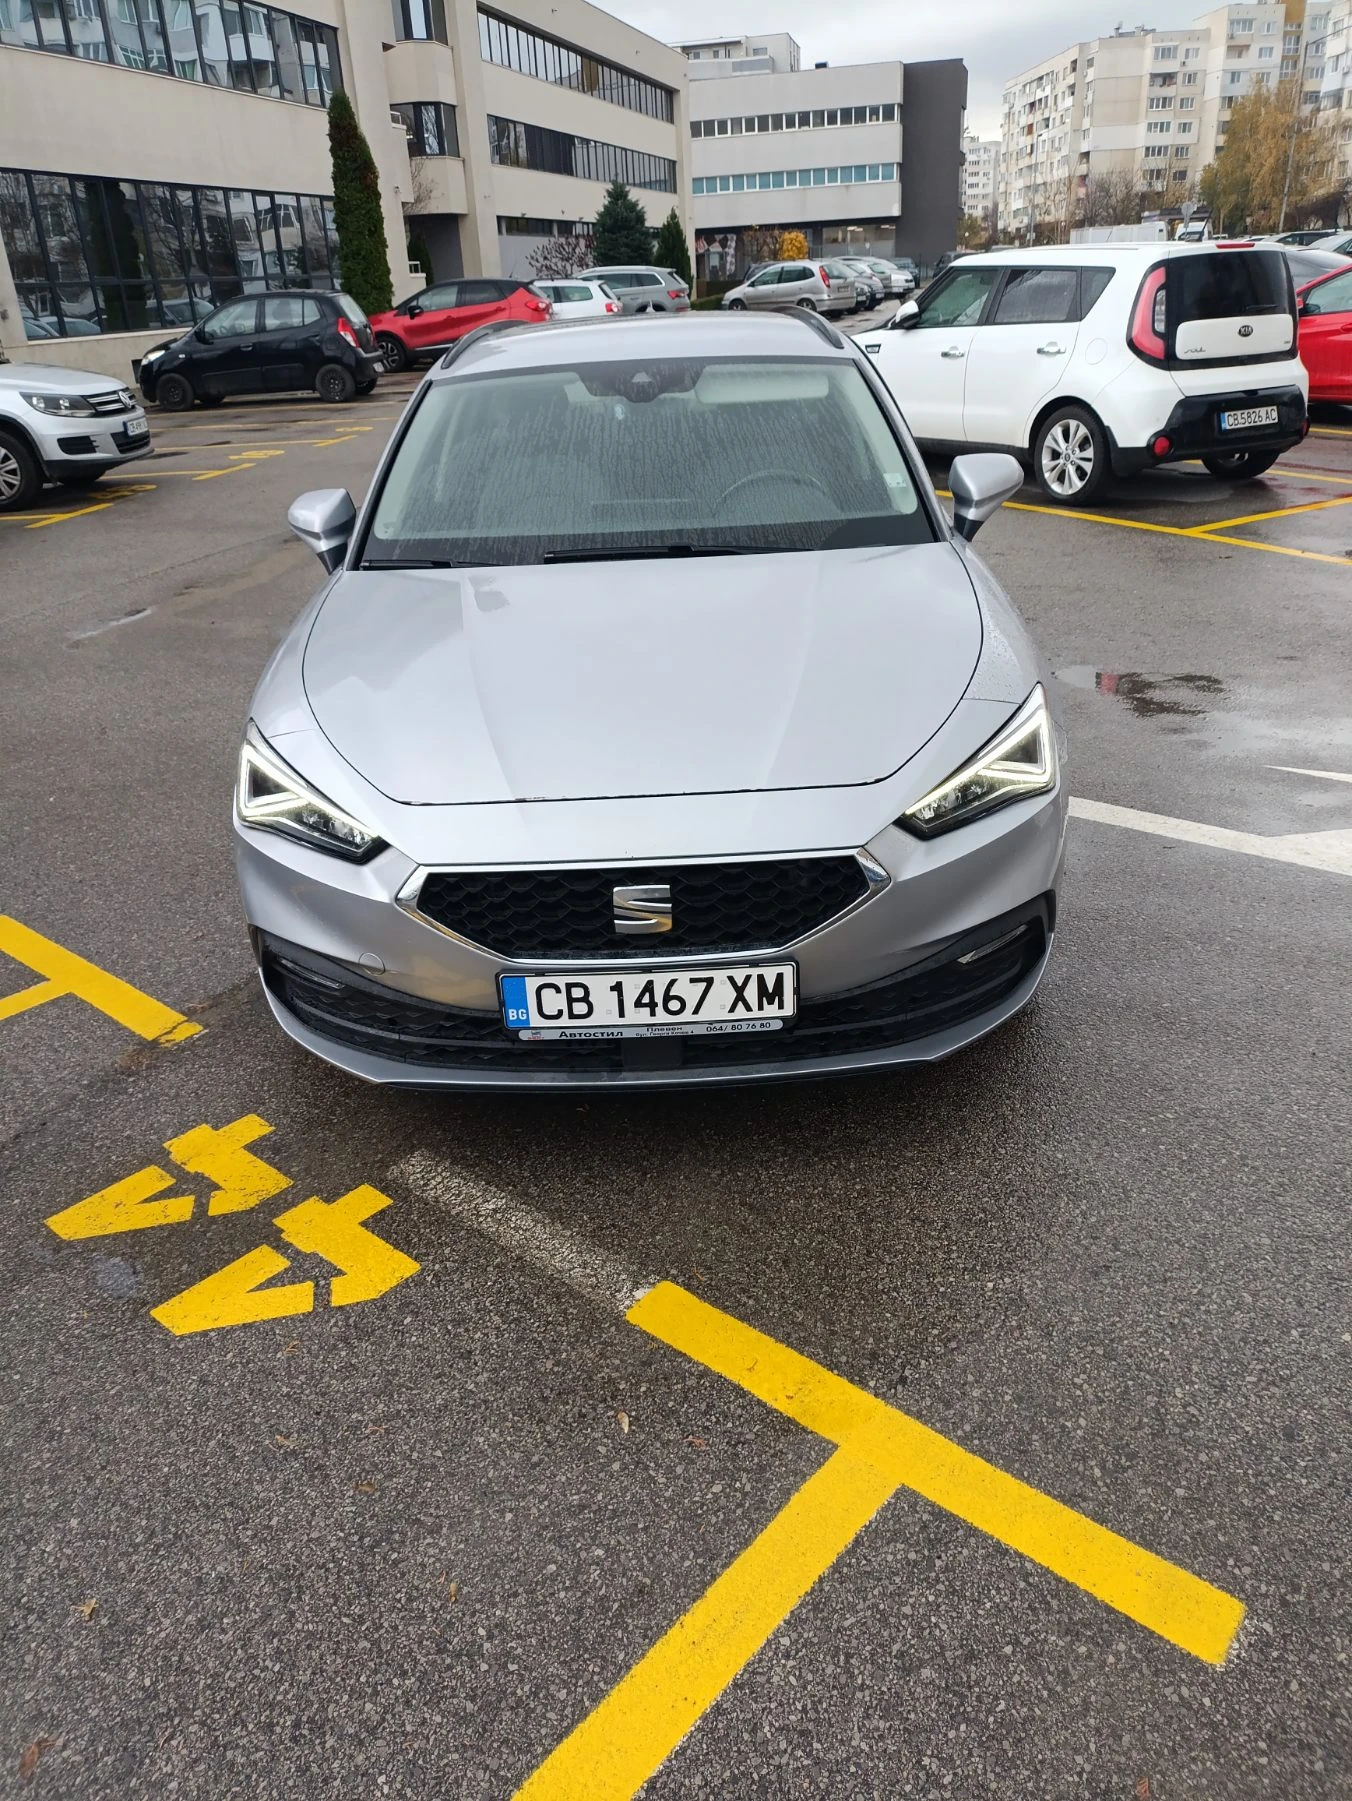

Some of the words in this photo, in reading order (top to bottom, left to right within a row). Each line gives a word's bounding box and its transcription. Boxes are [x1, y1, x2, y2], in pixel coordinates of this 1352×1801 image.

[535, 981, 594, 1021] CB
[609, 976, 715, 1019] 1467
[726, 972, 784, 1014] XM
[508, 1008, 528, 1021] BG
[705, 1024, 728, 1033] 064/
[730, 1023, 743, 1031] 80
[745, 1022, 757, 1030] 76
[759, 1021, 771, 1029] 80
[558, 1030, 624, 1039] Автостил
